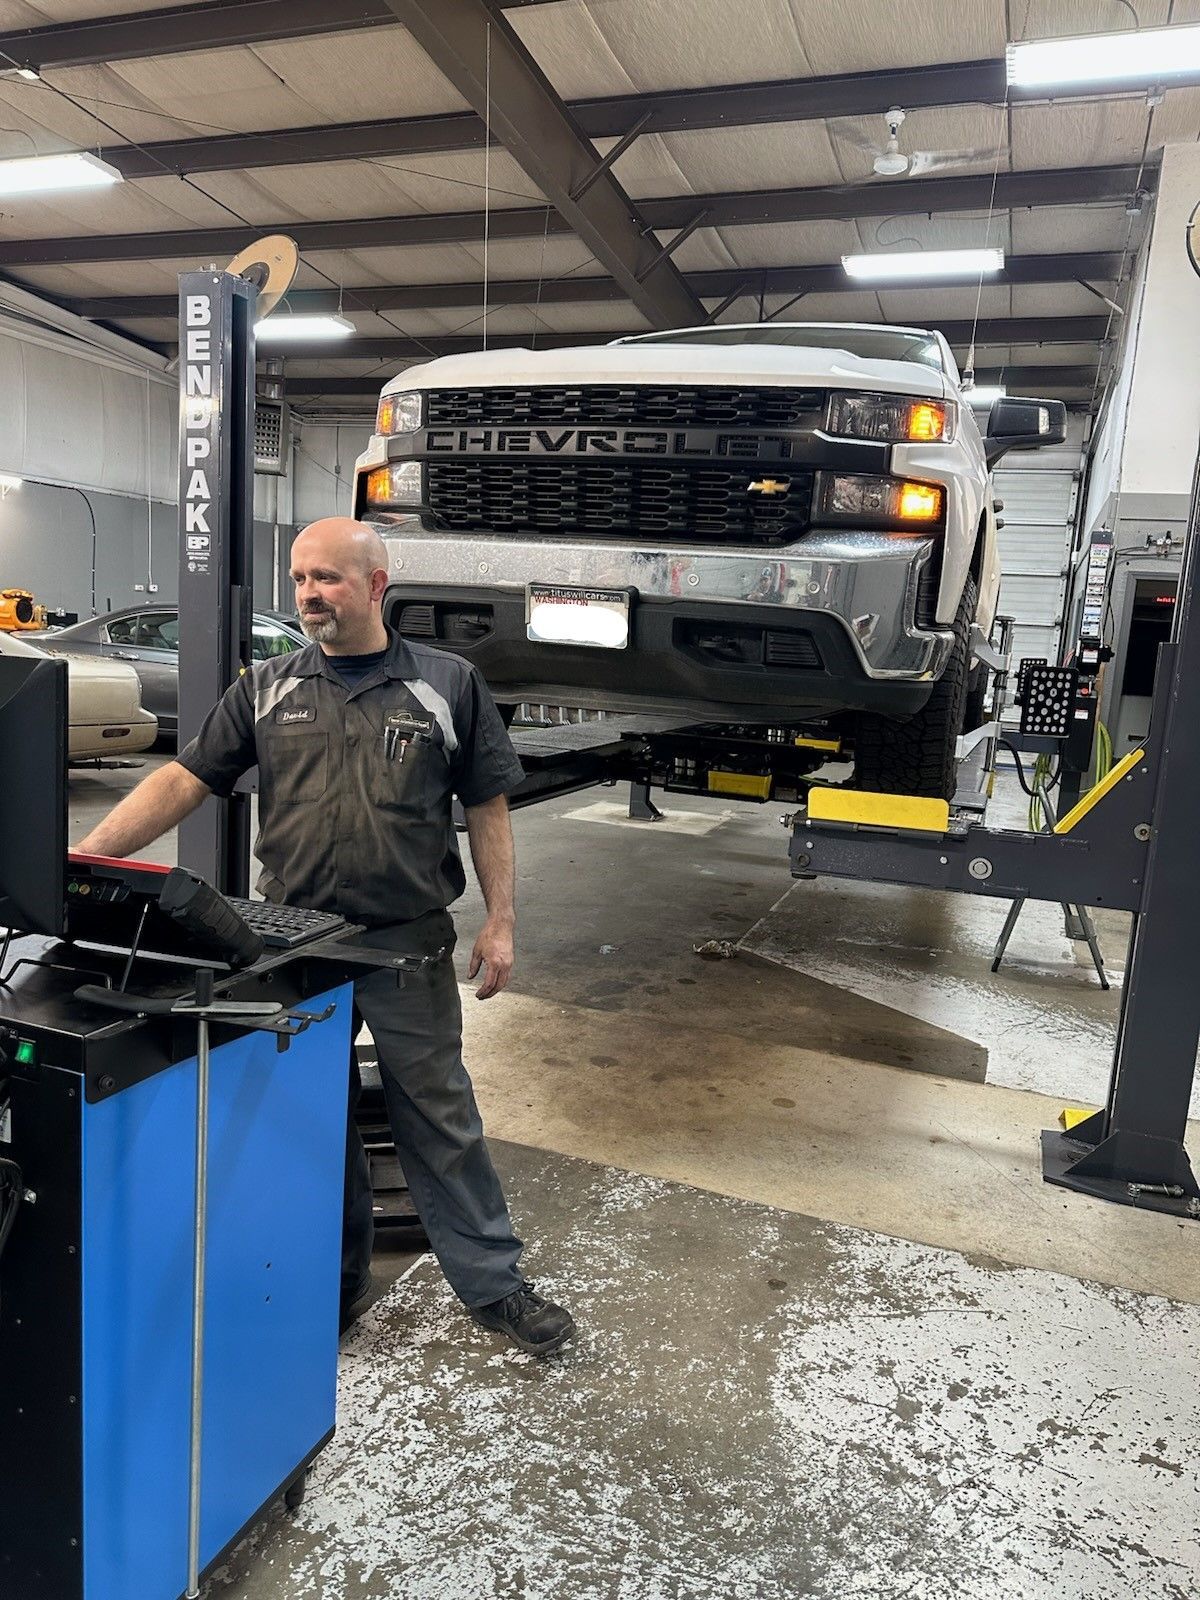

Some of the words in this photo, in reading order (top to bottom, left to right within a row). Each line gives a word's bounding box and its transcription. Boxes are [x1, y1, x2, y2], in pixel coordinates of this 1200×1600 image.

[186, 295, 211, 533] BENDPAK
[426, 430, 794, 458] CHEVROLET
[188, 536, 209, 549] BP
[534, 596, 589, 606] WASHINGTON
[282, 710, 308, 721] David
